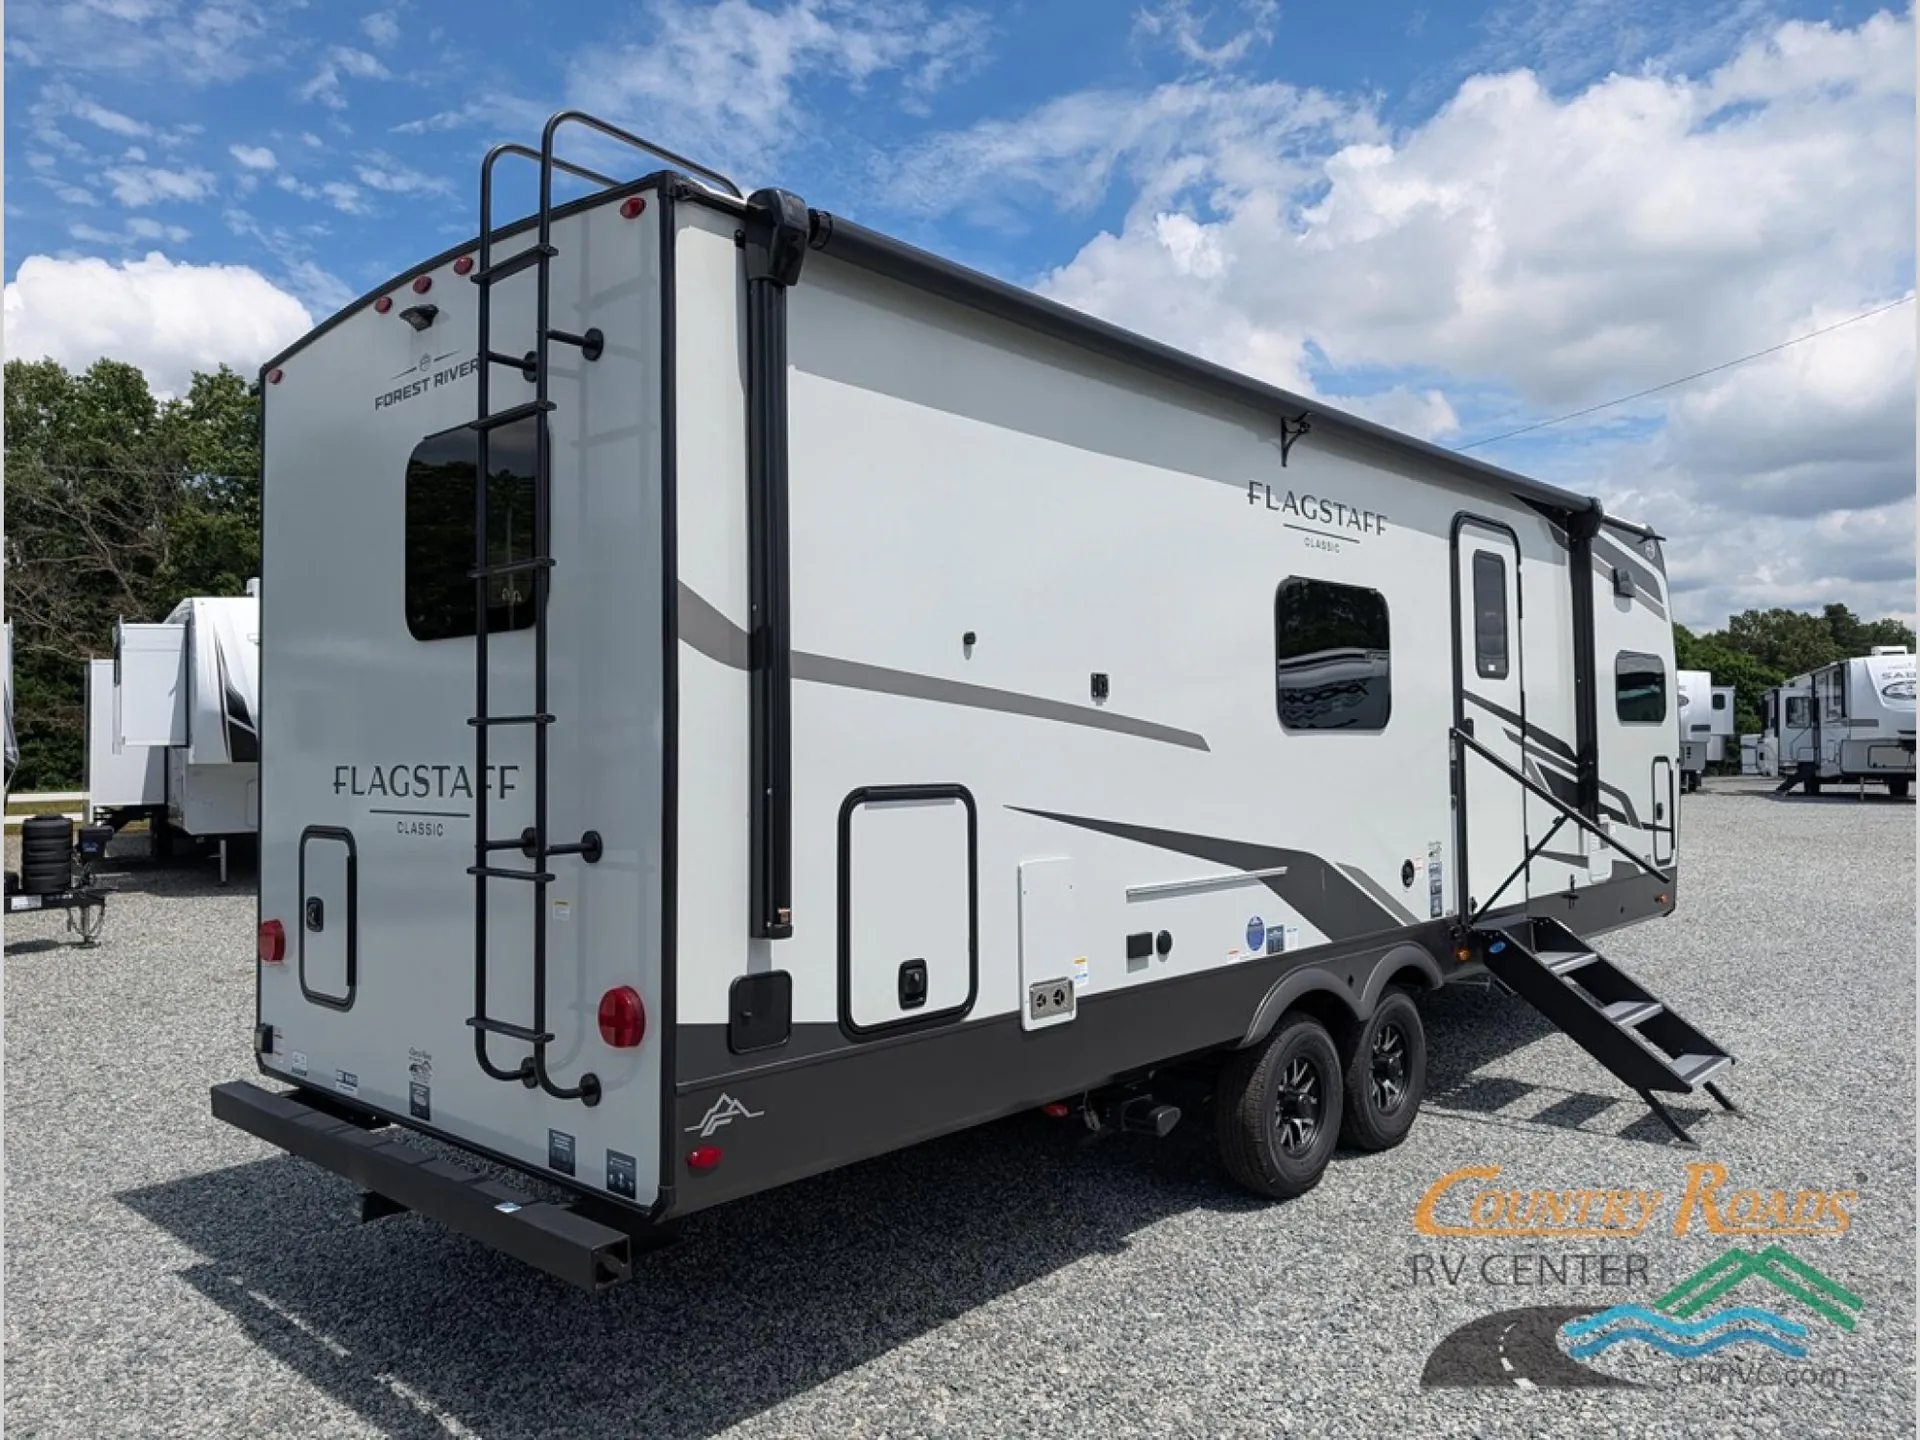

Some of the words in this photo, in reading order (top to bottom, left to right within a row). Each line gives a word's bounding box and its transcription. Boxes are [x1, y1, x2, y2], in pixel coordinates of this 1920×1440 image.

[375, 377, 430, 410] FOREST
[433, 358, 480, 388] RIVER
[1247, 480, 1388, 535] FLAGSTAFF
[1304, 537, 1340, 553] CLASSIC
[396, 820, 445, 837] CLASSIC
